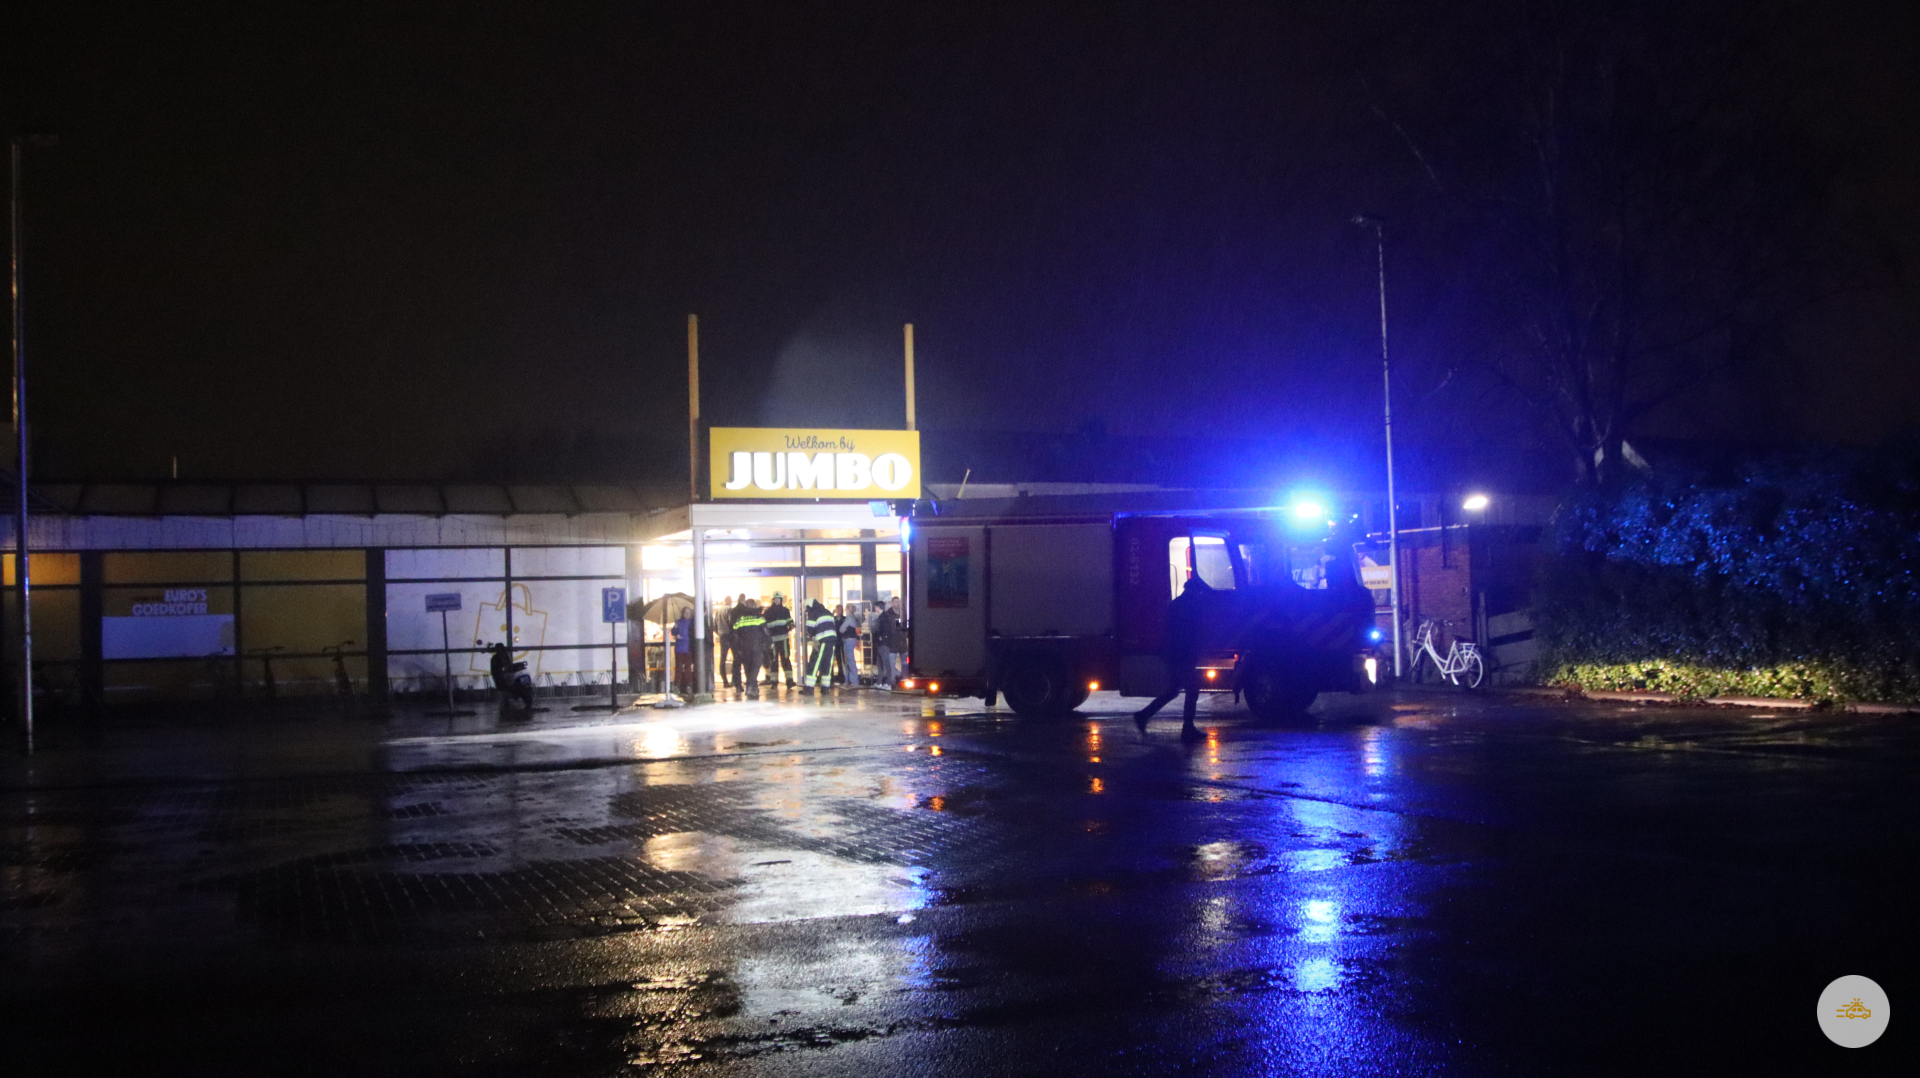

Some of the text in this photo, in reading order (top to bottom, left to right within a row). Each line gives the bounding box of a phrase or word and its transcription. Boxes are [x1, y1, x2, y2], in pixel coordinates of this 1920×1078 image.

[785, 435, 856, 452] Welkom bij
[724, 451, 913, 491] JUMBO
[164, 589, 207, 602] EURO'S
[607, 591, 620, 609] P
